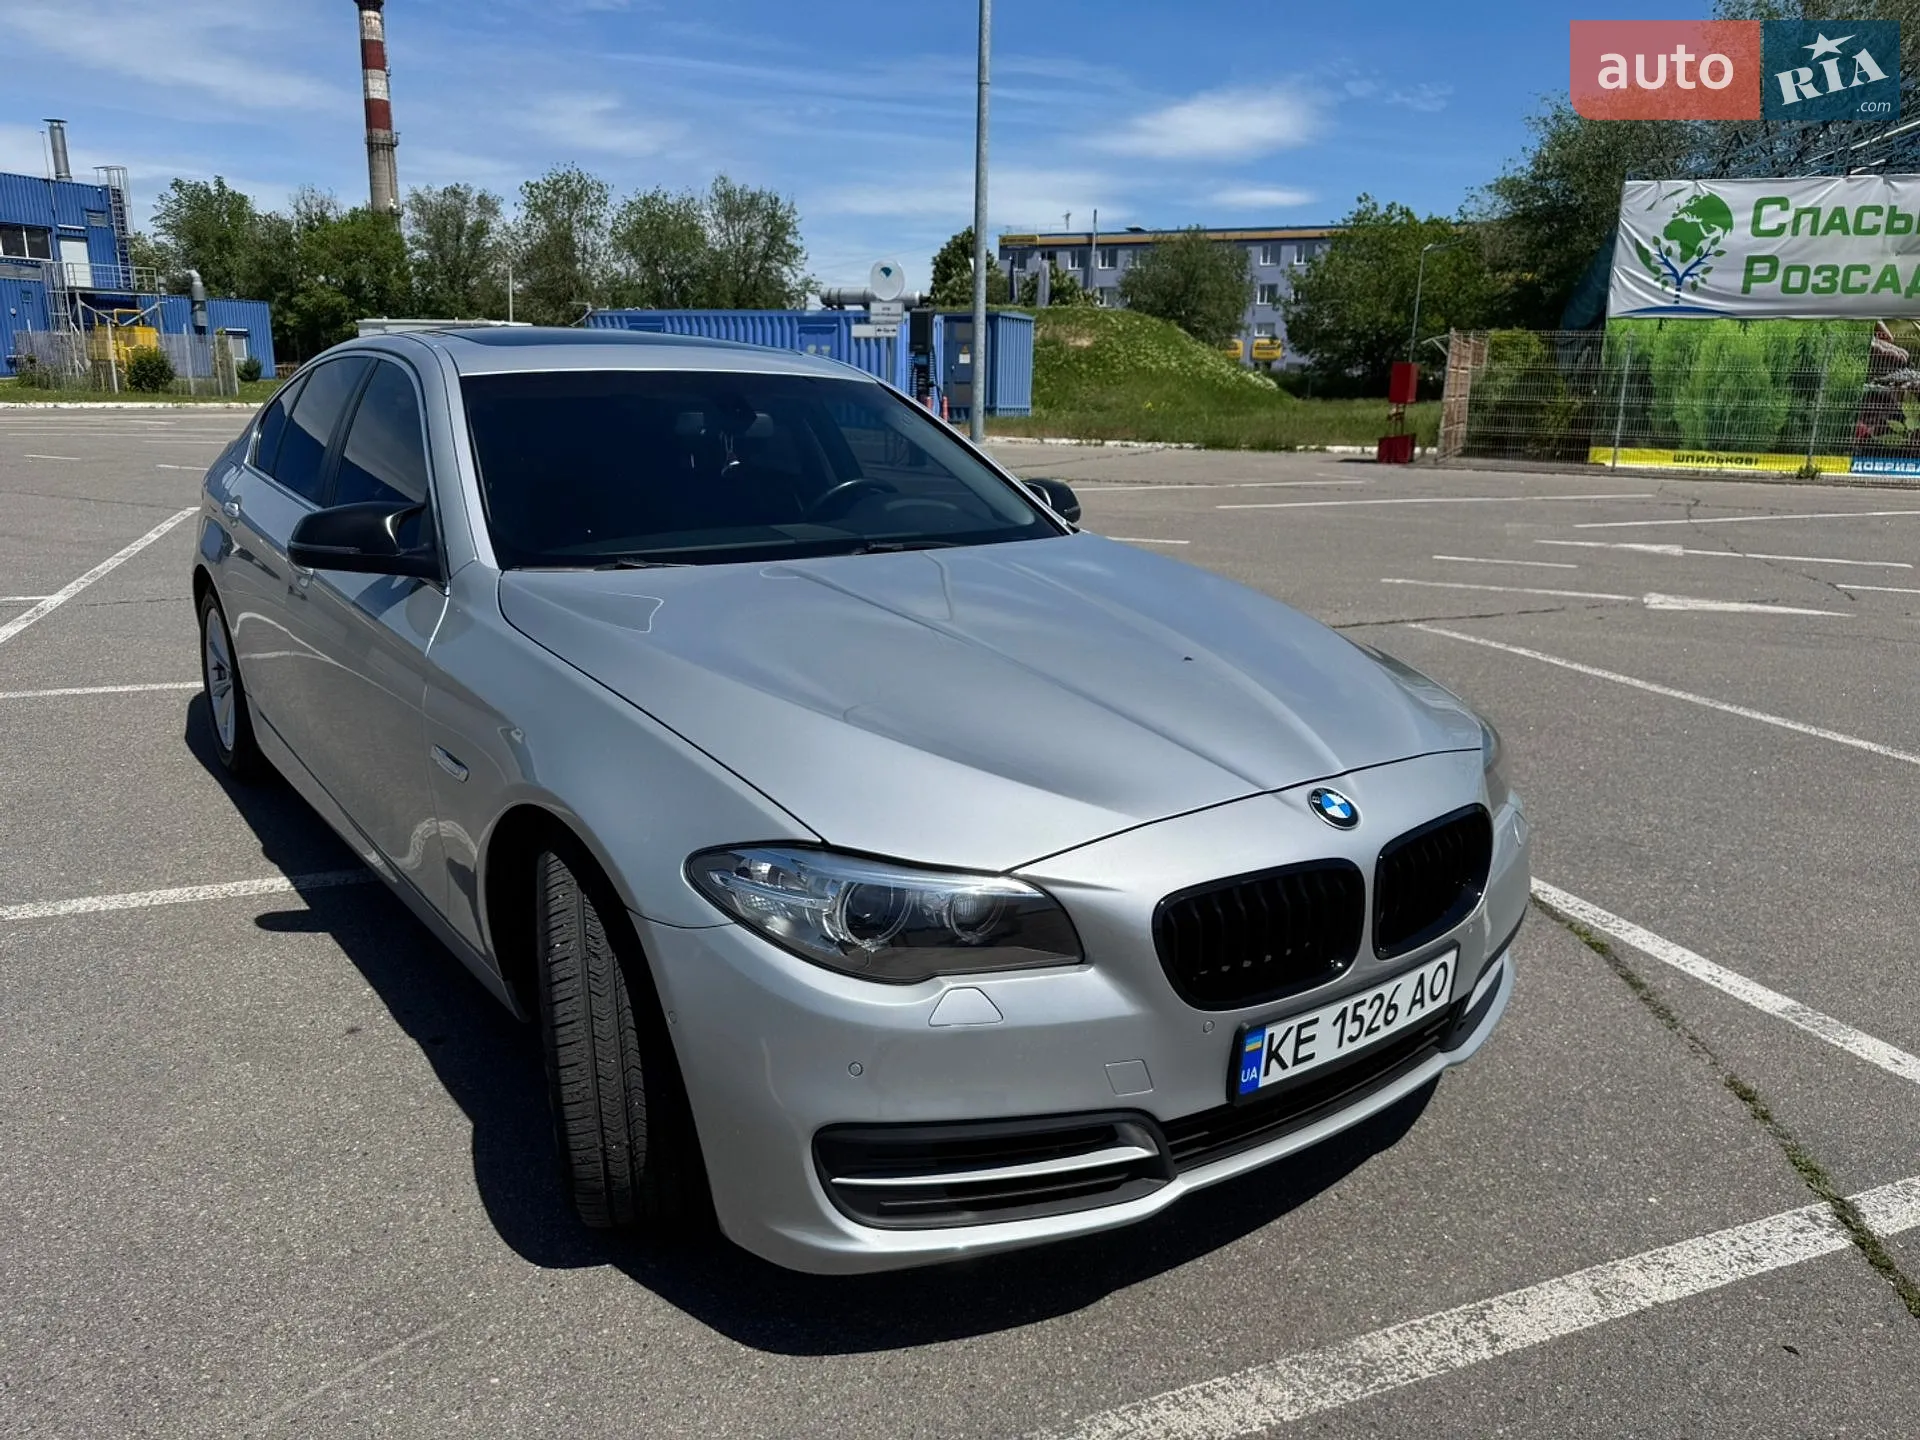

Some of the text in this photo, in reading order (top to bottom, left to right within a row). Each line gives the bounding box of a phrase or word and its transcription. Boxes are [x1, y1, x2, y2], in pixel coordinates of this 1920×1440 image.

[1851, 461, 1920, 472] ДОБРИВ
[1263, 961, 1448, 1077] KE 1526 AO
[1241, 1069, 1258, 1083] UA
